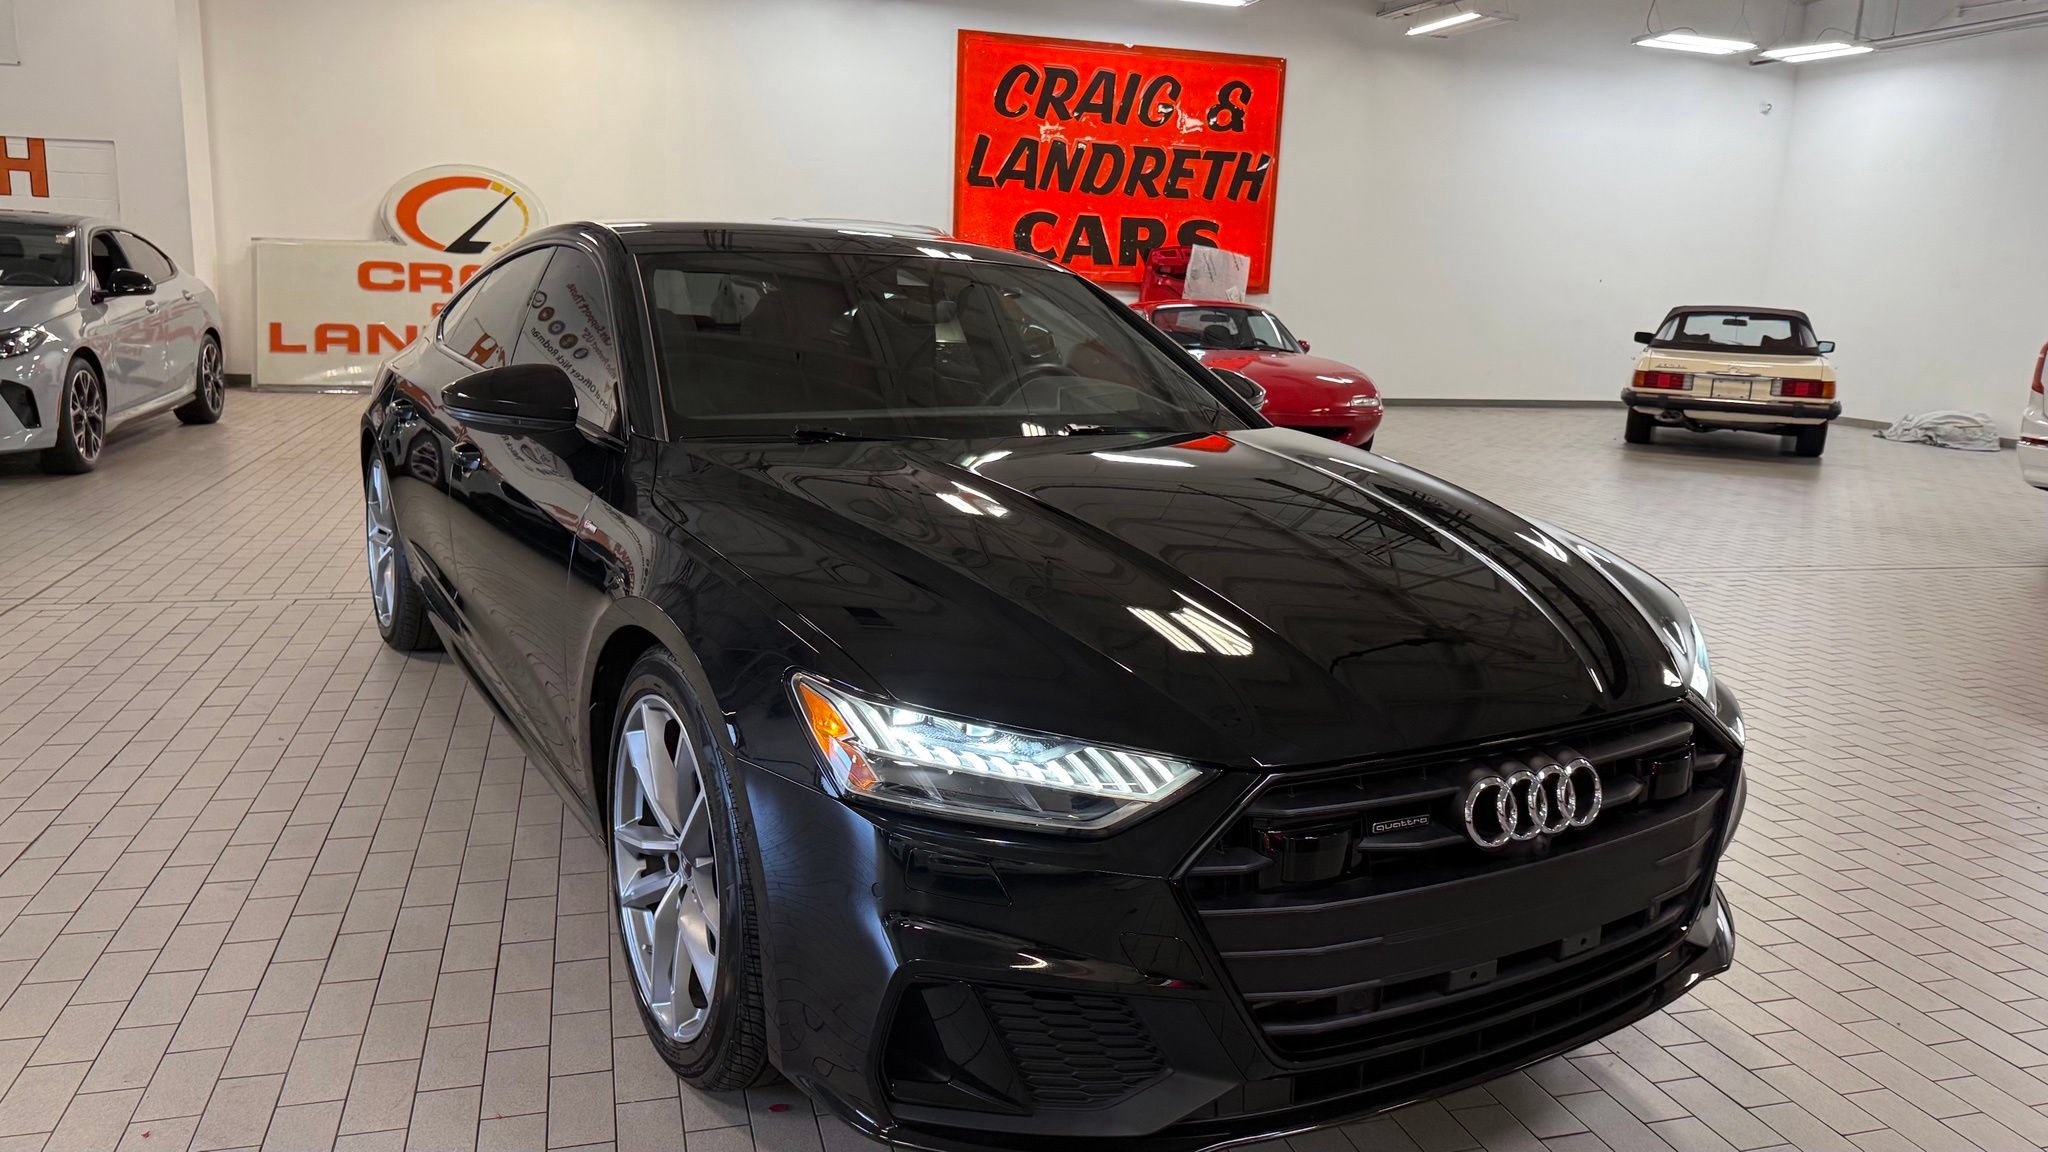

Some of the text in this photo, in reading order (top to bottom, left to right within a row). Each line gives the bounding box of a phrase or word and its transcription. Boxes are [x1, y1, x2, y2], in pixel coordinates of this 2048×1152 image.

[993, 63, 1252, 132] CRAIG &
[966, 134, 1271, 201] LANDRETH
[358, 261, 482, 293] CR
[1375, 817, 1428, 832] quattro
